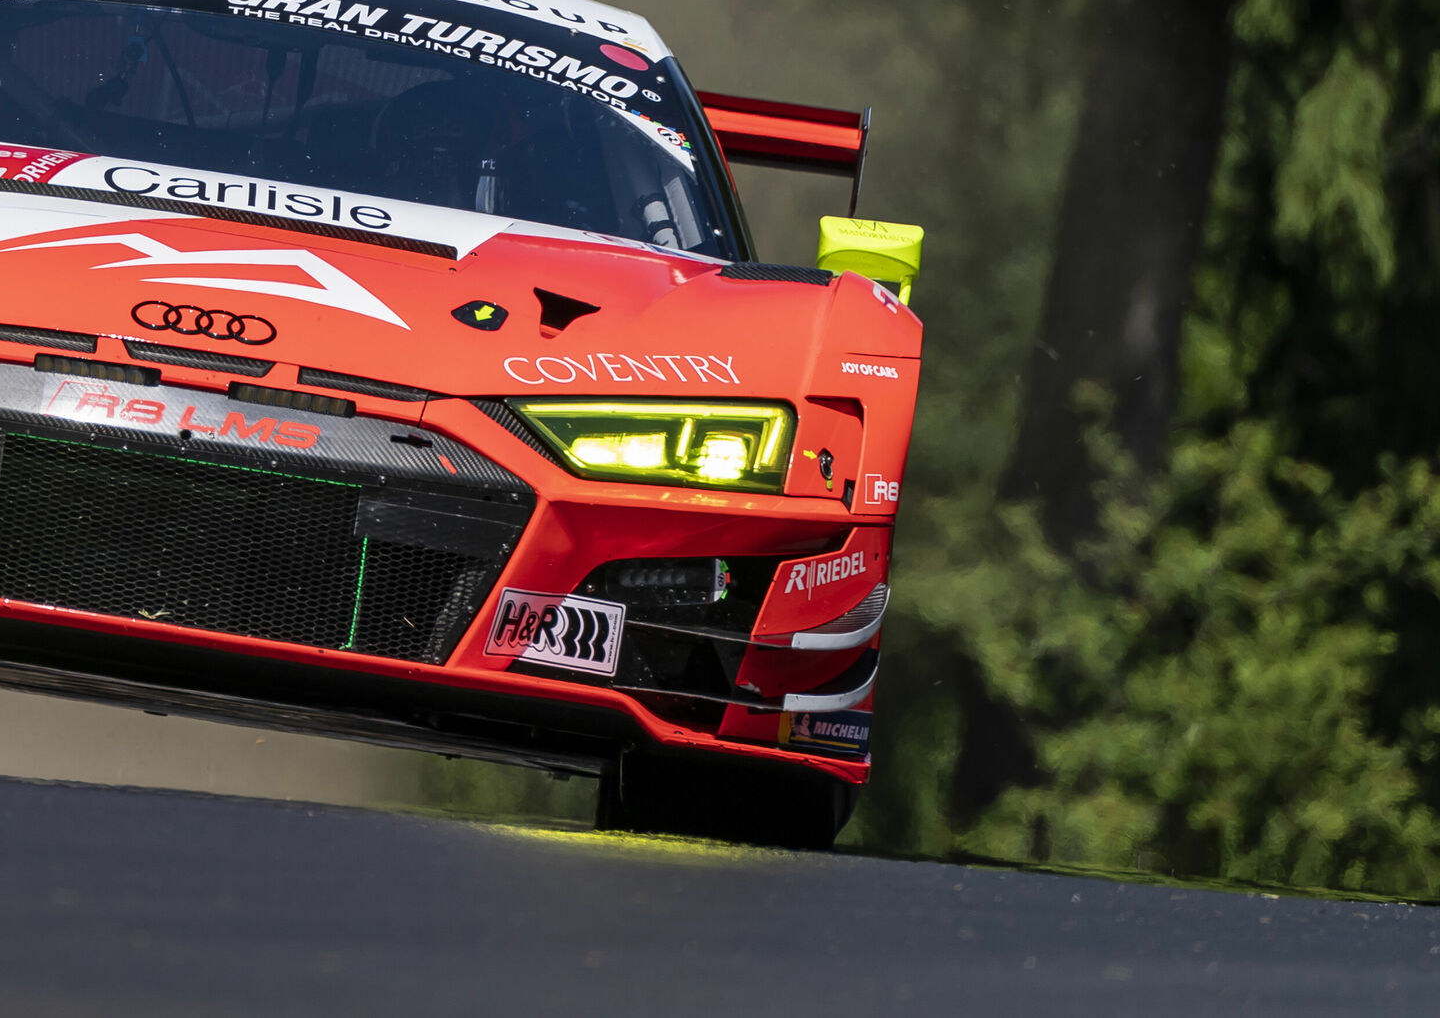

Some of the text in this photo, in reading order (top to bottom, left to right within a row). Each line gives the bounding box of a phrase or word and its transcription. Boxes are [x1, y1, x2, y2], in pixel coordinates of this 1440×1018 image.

[227, 5, 628, 111] THE REAL DRIVING SIMULATOR
[103, 166, 393, 230] Carlisle
[503, 352, 741, 385] COVENTRY
[73, 391, 322, 450] R8 LMS
[872, 478, 900, 502] R8
[816, 550, 867, 587] RIEDEL
[494, 599, 563, 654] H&R
